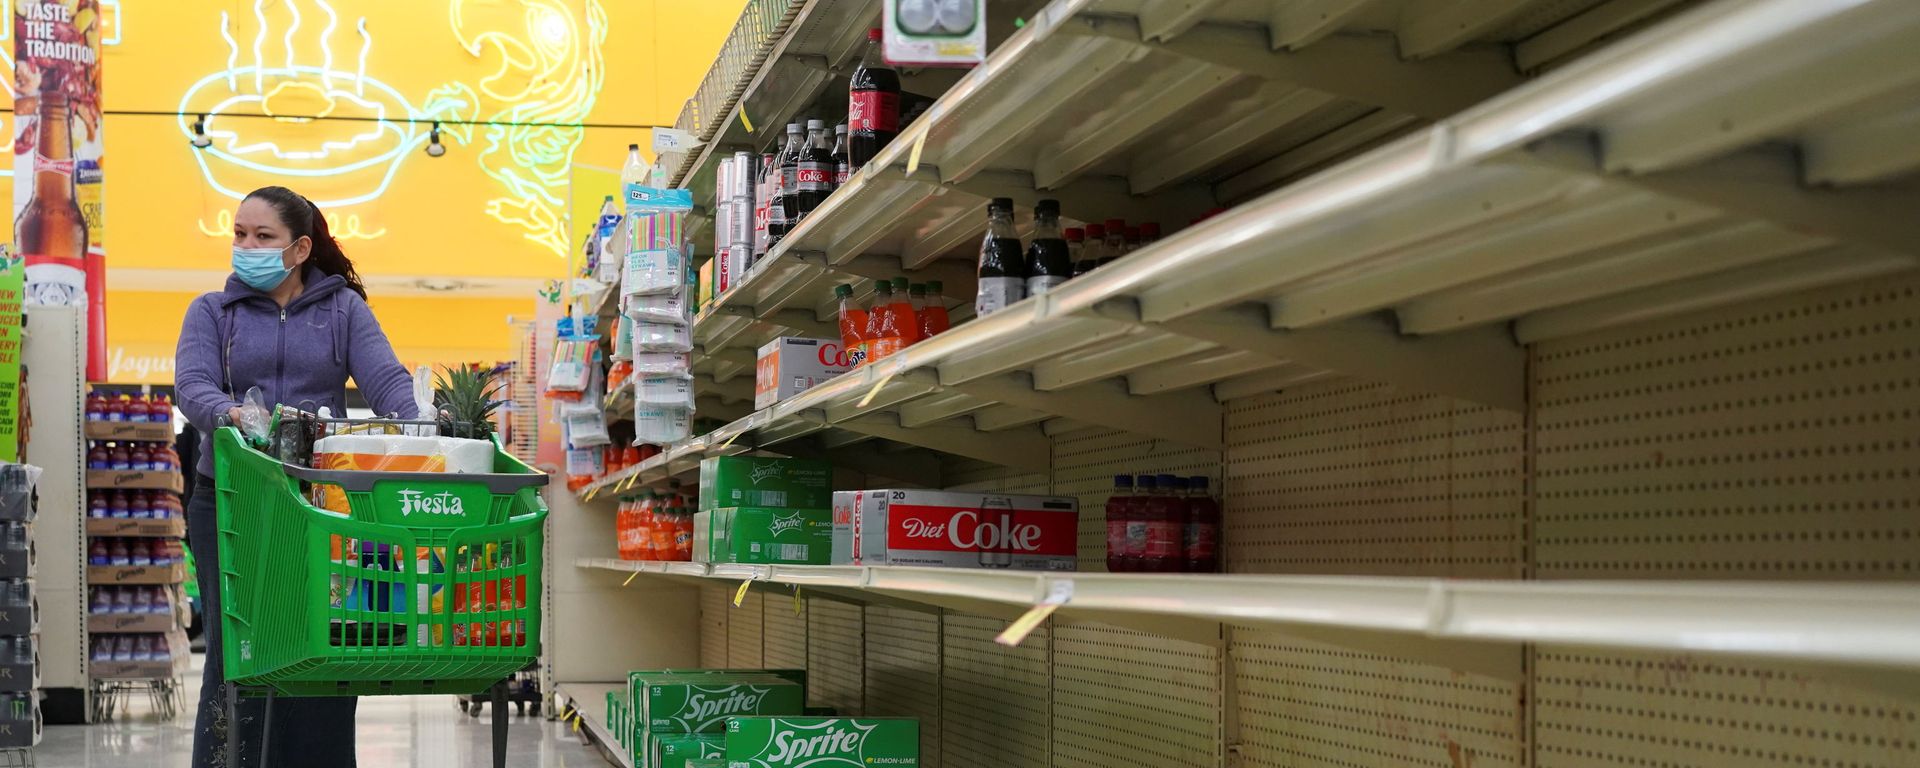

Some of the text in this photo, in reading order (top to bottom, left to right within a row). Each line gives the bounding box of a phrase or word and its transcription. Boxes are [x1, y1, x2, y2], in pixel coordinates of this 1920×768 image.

[24, 2, 70, 23] TASTE
[25, 20, 56, 40] THE
[25, 39, 96, 65] TRADITION
[798, 170, 823, 182] Coke
[752, 467, 780, 478] Sprite
[397, 488, 464, 517] Fiesta
[892, 491, 905, 499] 20
[772, 518, 801, 530] Sprite
[902, 510, 1042, 551] Diet Coke
[683, 690, 757, 722] Sprite
[729, 721, 740, 729] 12
[767, 726, 860, 766] Sprite
[873, 757, 916, 765] LEMON-LIME
